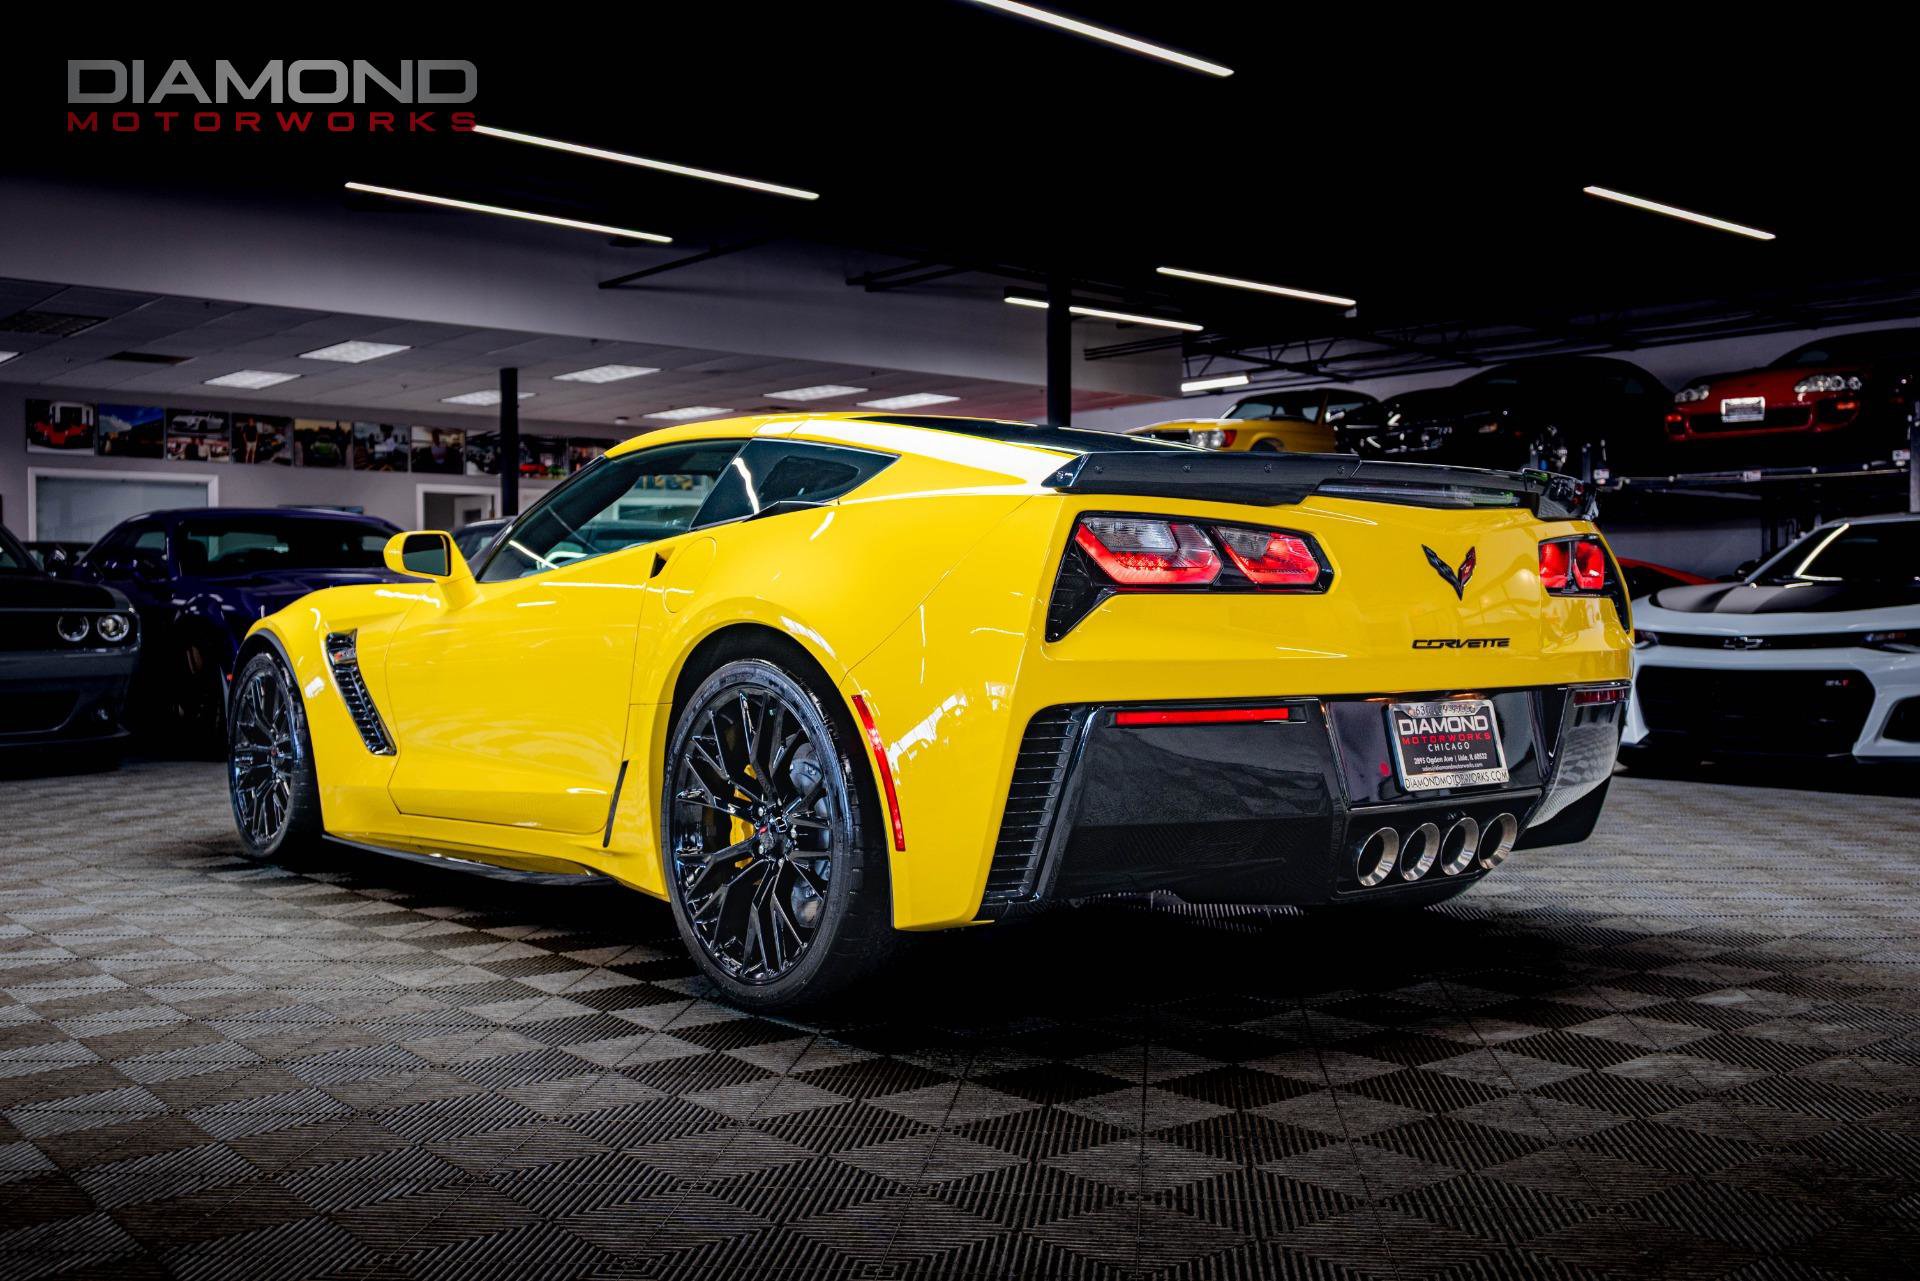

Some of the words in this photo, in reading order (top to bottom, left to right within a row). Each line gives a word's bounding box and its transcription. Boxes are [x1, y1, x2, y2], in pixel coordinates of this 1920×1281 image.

[1412, 638, 1511, 649] CORVETTE
[1398, 715, 1489, 736] DIAMOND
[1402, 731, 1492, 746] MOTORWORKS
[1427, 741, 1471, 753] CHICAGO
[1405, 770, 1509, 789] DIAMONDMOTORWORKS.COM
